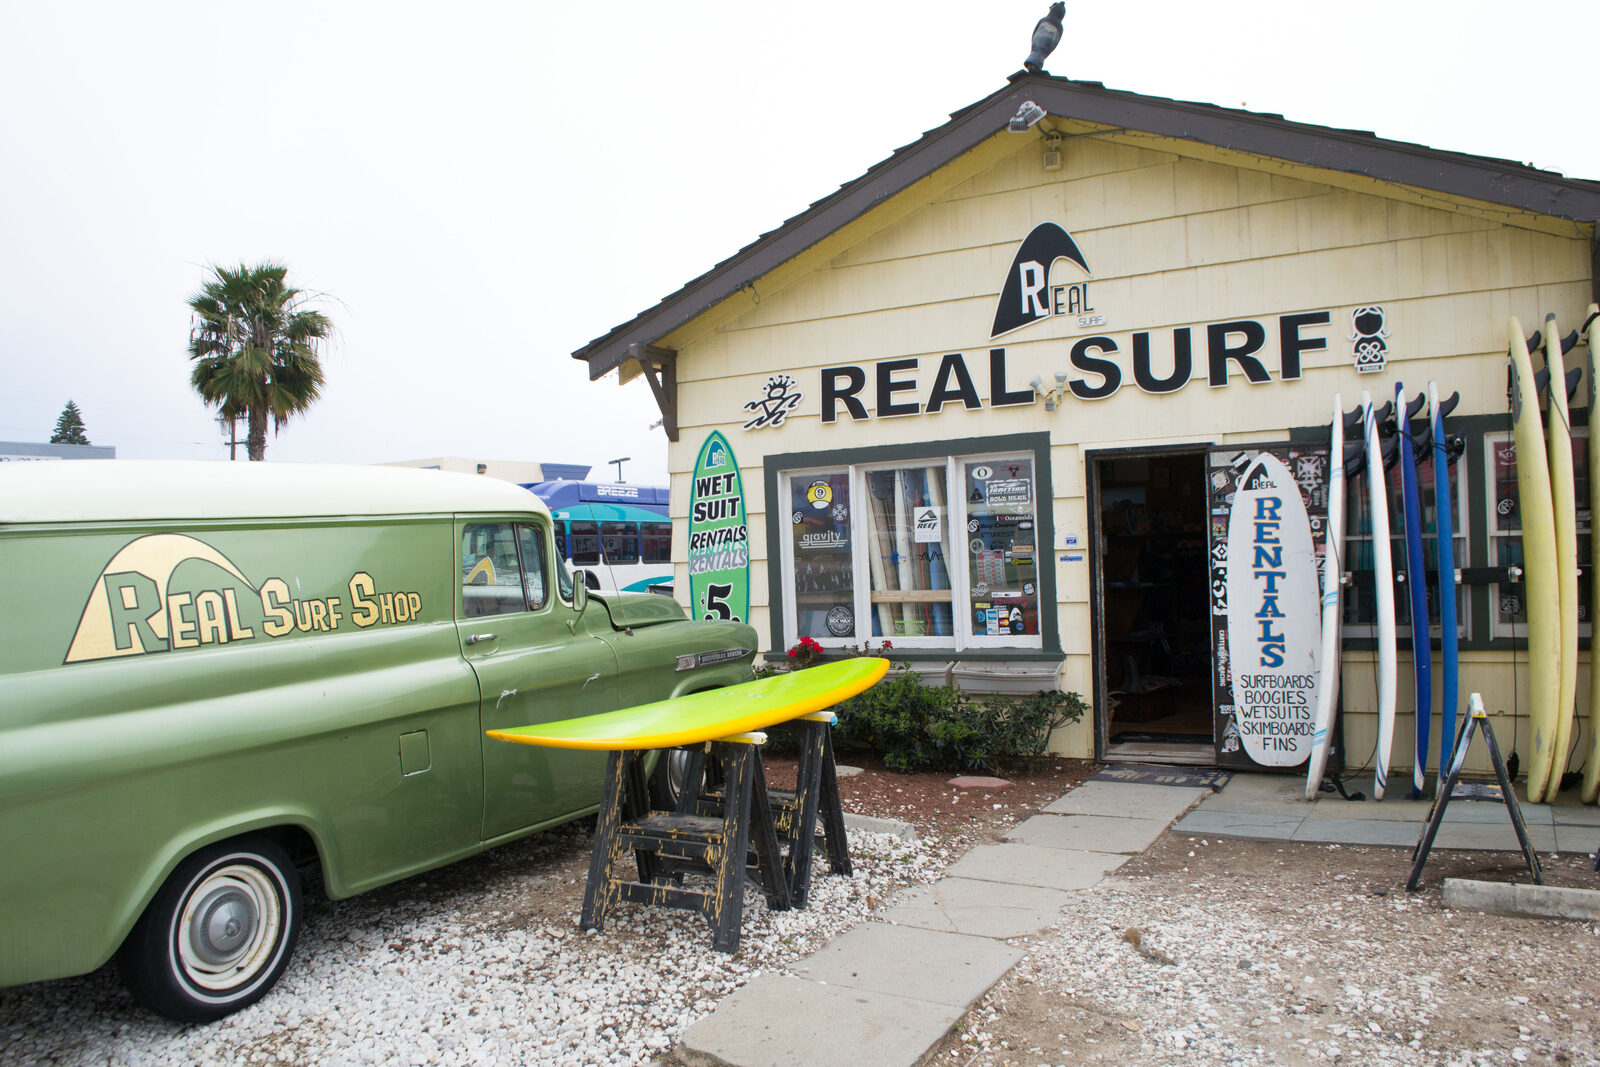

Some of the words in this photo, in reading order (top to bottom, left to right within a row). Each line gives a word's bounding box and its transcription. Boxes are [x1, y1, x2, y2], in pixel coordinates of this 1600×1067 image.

[1019, 260, 1095, 316] REAL
[1078, 315, 1103, 326] SURF
[820, 347, 1036, 423] REAL
[1068, 310, 1332, 401] SURF
[597, 486, 638, 497] BREEZE
[696, 472, 736, 498] WET
[1252, 479, 1277, 489] REAL
[693, 496, 740, 522] SUIT
[690, 525, 747, 551] RENTALS
[800, 530, 845, 547] gravity
[689, 549, 747, 574] RENTALS
[1251, 496, 1287, 668] RENTALS
[103, 571, 255, 654] REAL
[259, 577, 343, 638] SURF
[348, 571, 422, 628] SHOP
[1240, 674, 1315, 689] SURFBOARDS
[1244, 690, 1307, 705] BOOGIES
[1240, 705, 1311, 720] WETSUITS
[1242, 721, 1316, 736] SKIMBOARDS
[1262, 737, 1298, 752] FINS
